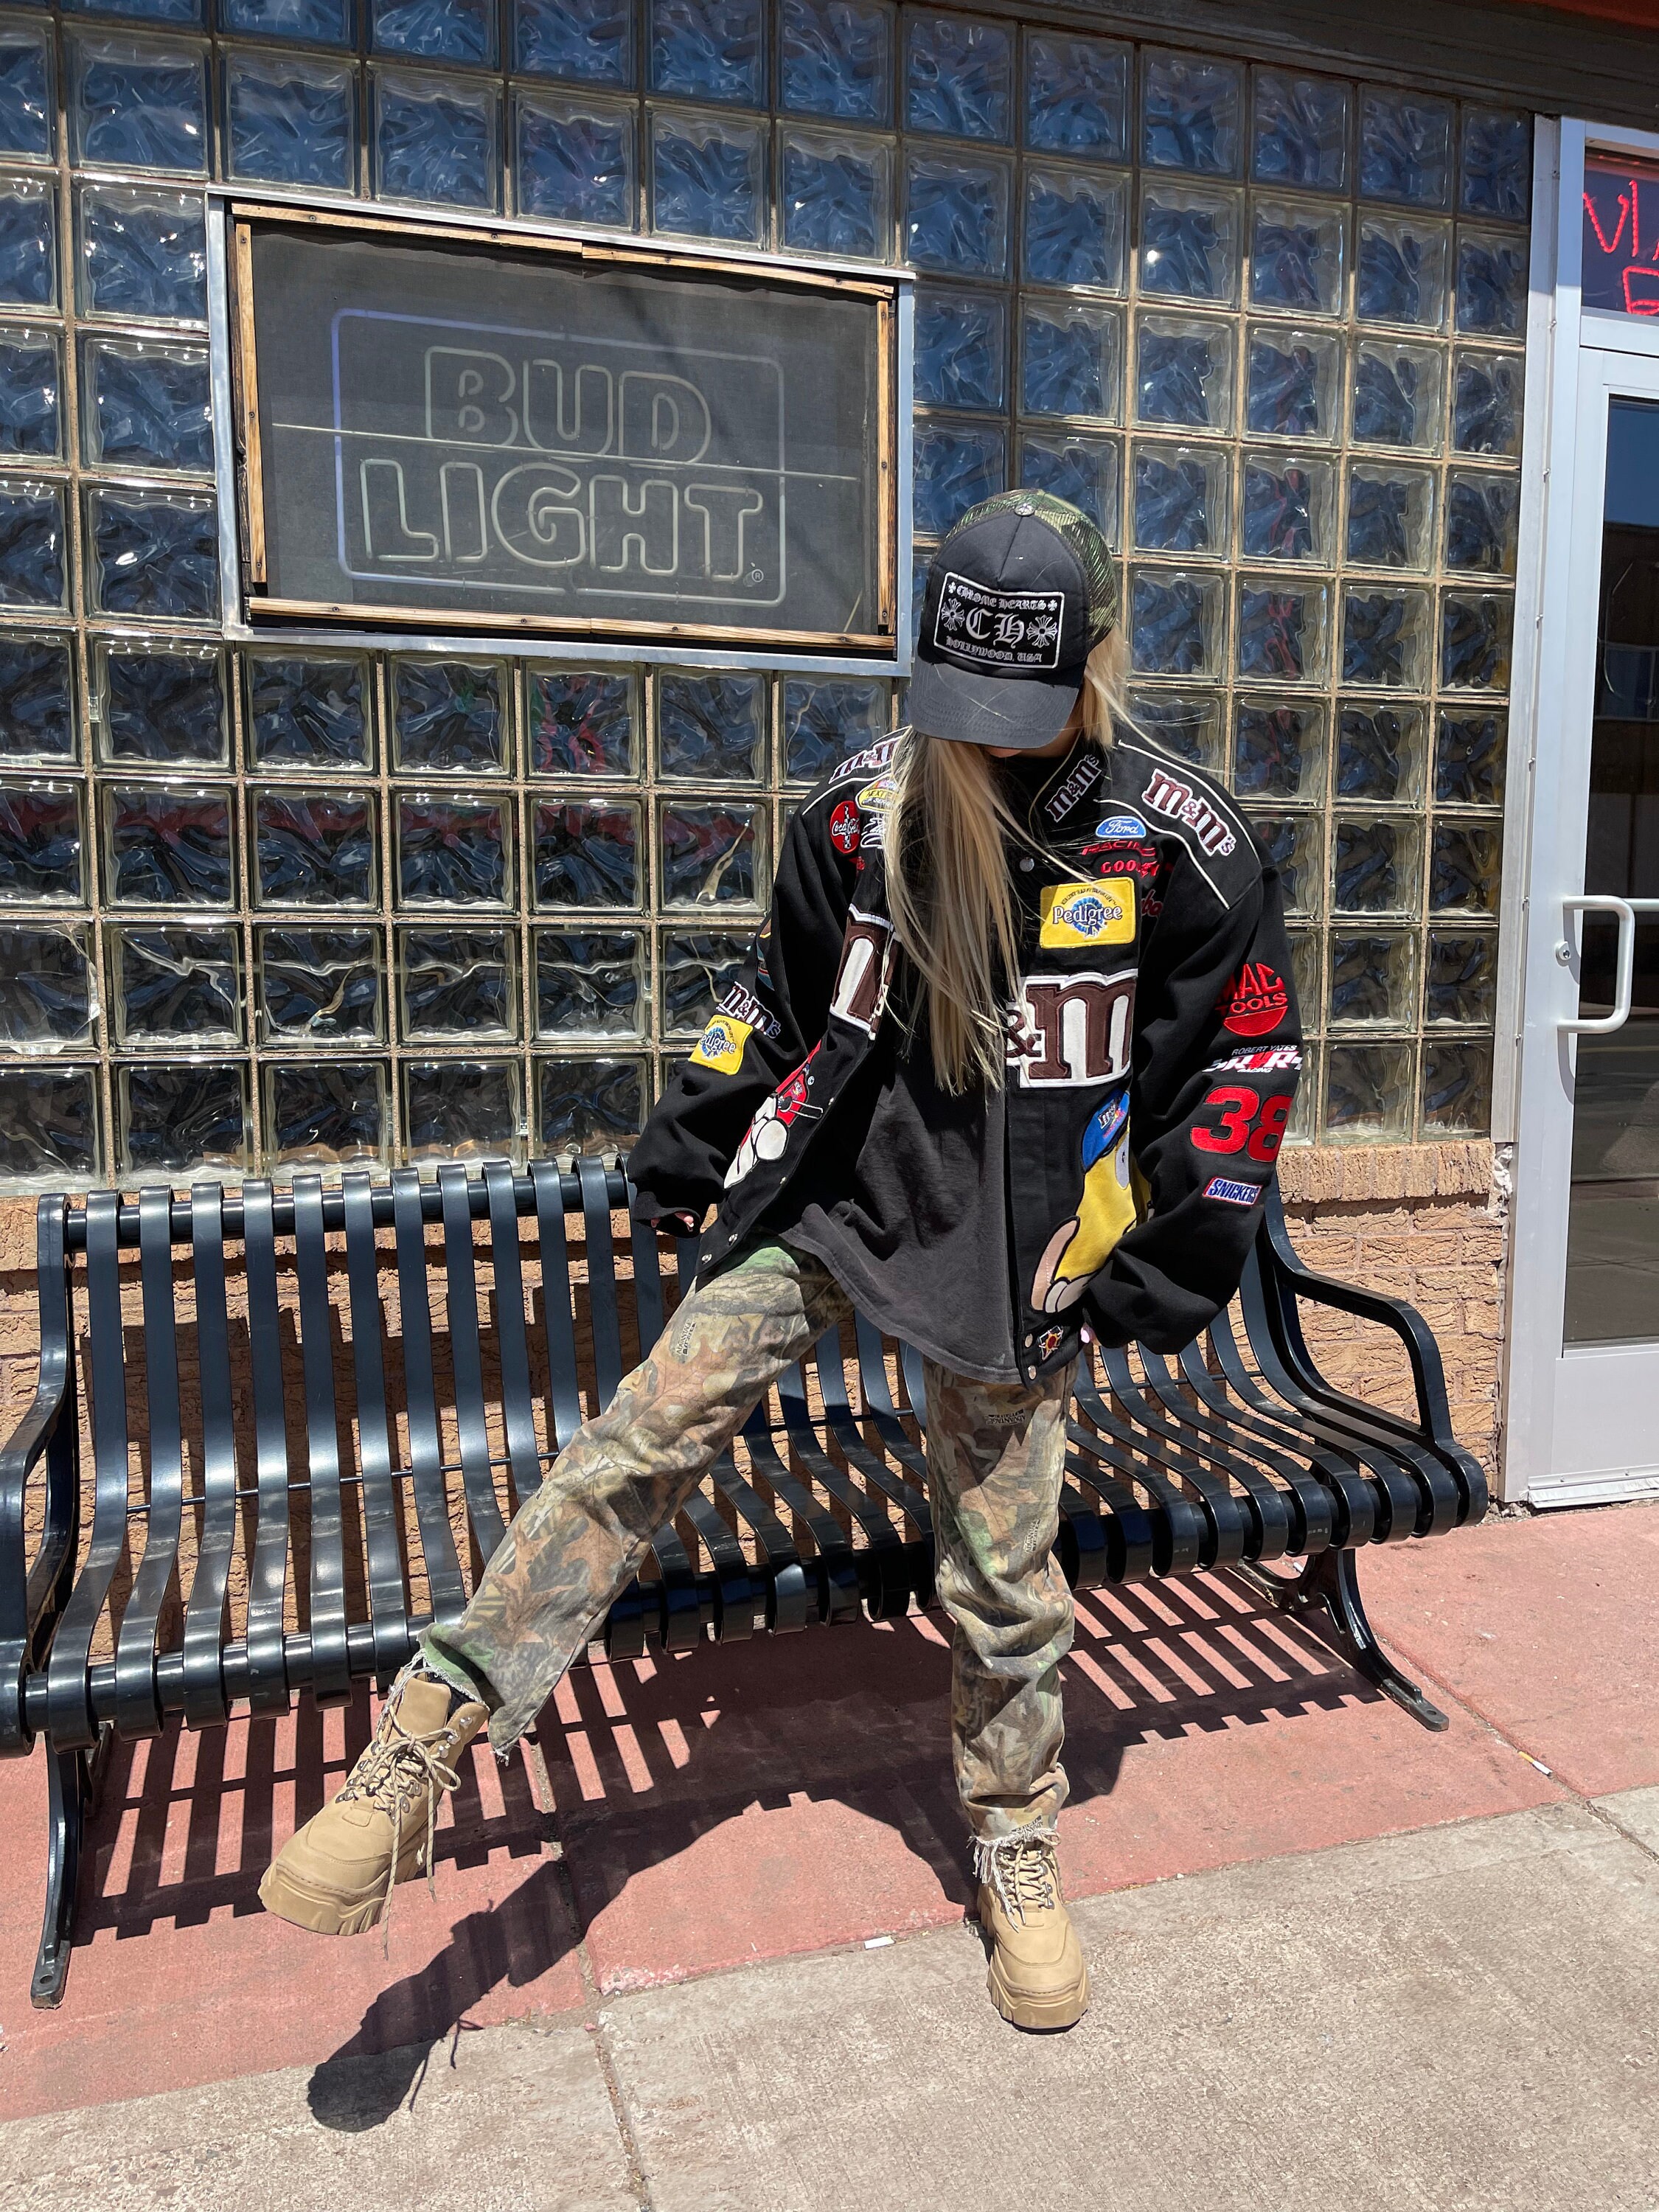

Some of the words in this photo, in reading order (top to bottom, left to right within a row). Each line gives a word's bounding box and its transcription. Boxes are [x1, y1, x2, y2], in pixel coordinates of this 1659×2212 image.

[425, 345, 712, 470] BUD
[360, 458, 764, 582] LIGHT
[957, 585, 997, 607] CHROME
[998, 598, 1046, 611] HEARTS
[1017, 652, 1043, 663] USA
[1105, 819, 1141, 834] Ford
[1052, 905, 1123, 927] Pedigree
[700, 1034, 737, 1054] edigree
[1231, 1046, 1269, 1056] ROBERT
[1190, 1085, 1293, 1163] 38
